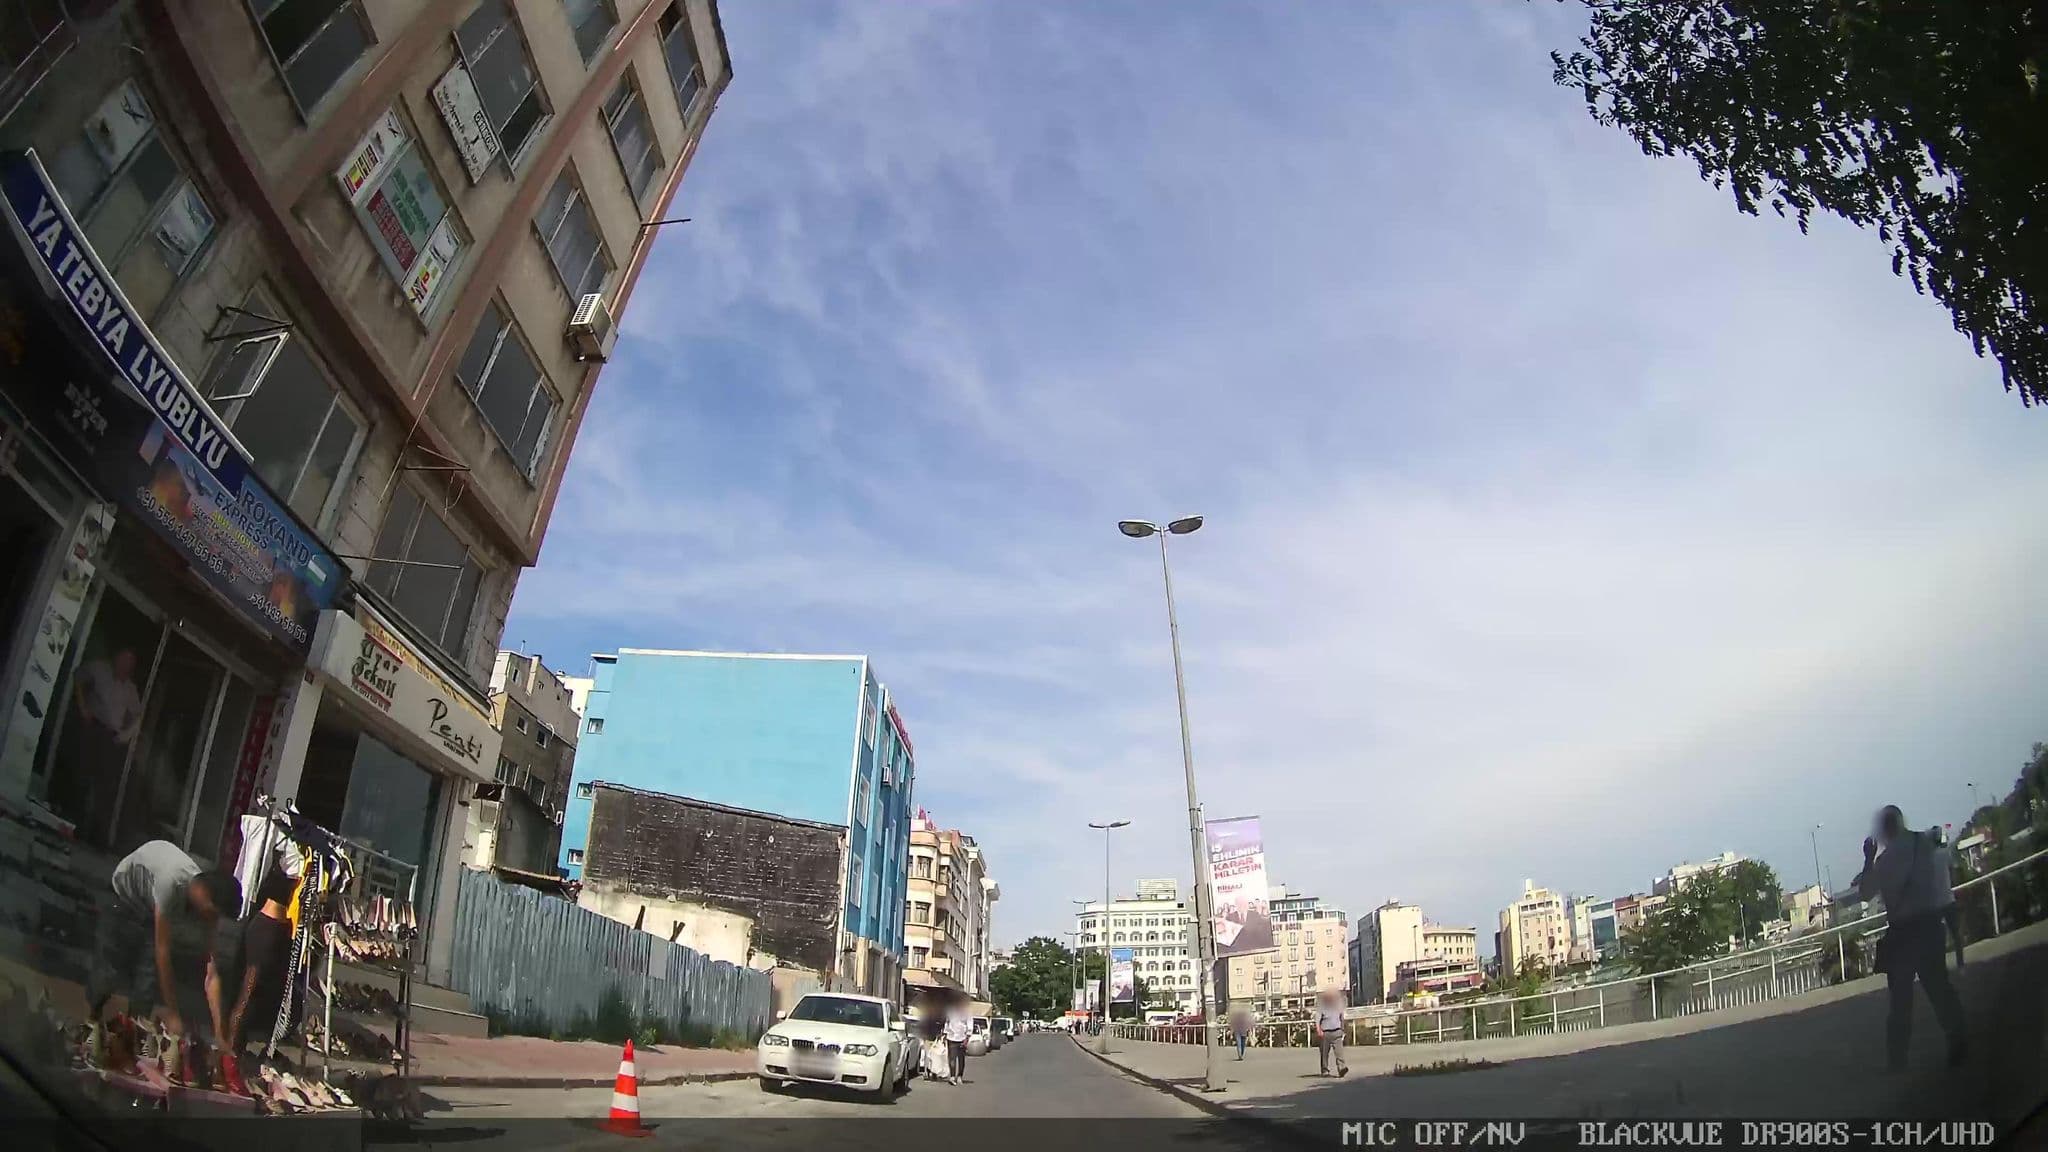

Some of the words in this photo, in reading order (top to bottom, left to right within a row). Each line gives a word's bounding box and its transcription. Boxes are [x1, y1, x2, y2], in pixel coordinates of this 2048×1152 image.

[27, 195, 62, 257] YA
[56, 241, 131, 354] TEBYA
[130, 343, 229, 470] LYUBLYU
[214, 492, 269, 550] EXPRESS
[236, 488, 310, 566] ROKAND
[427, 697, 484, 760] Penti
[1214, 857, 1254, 872] KARAR
